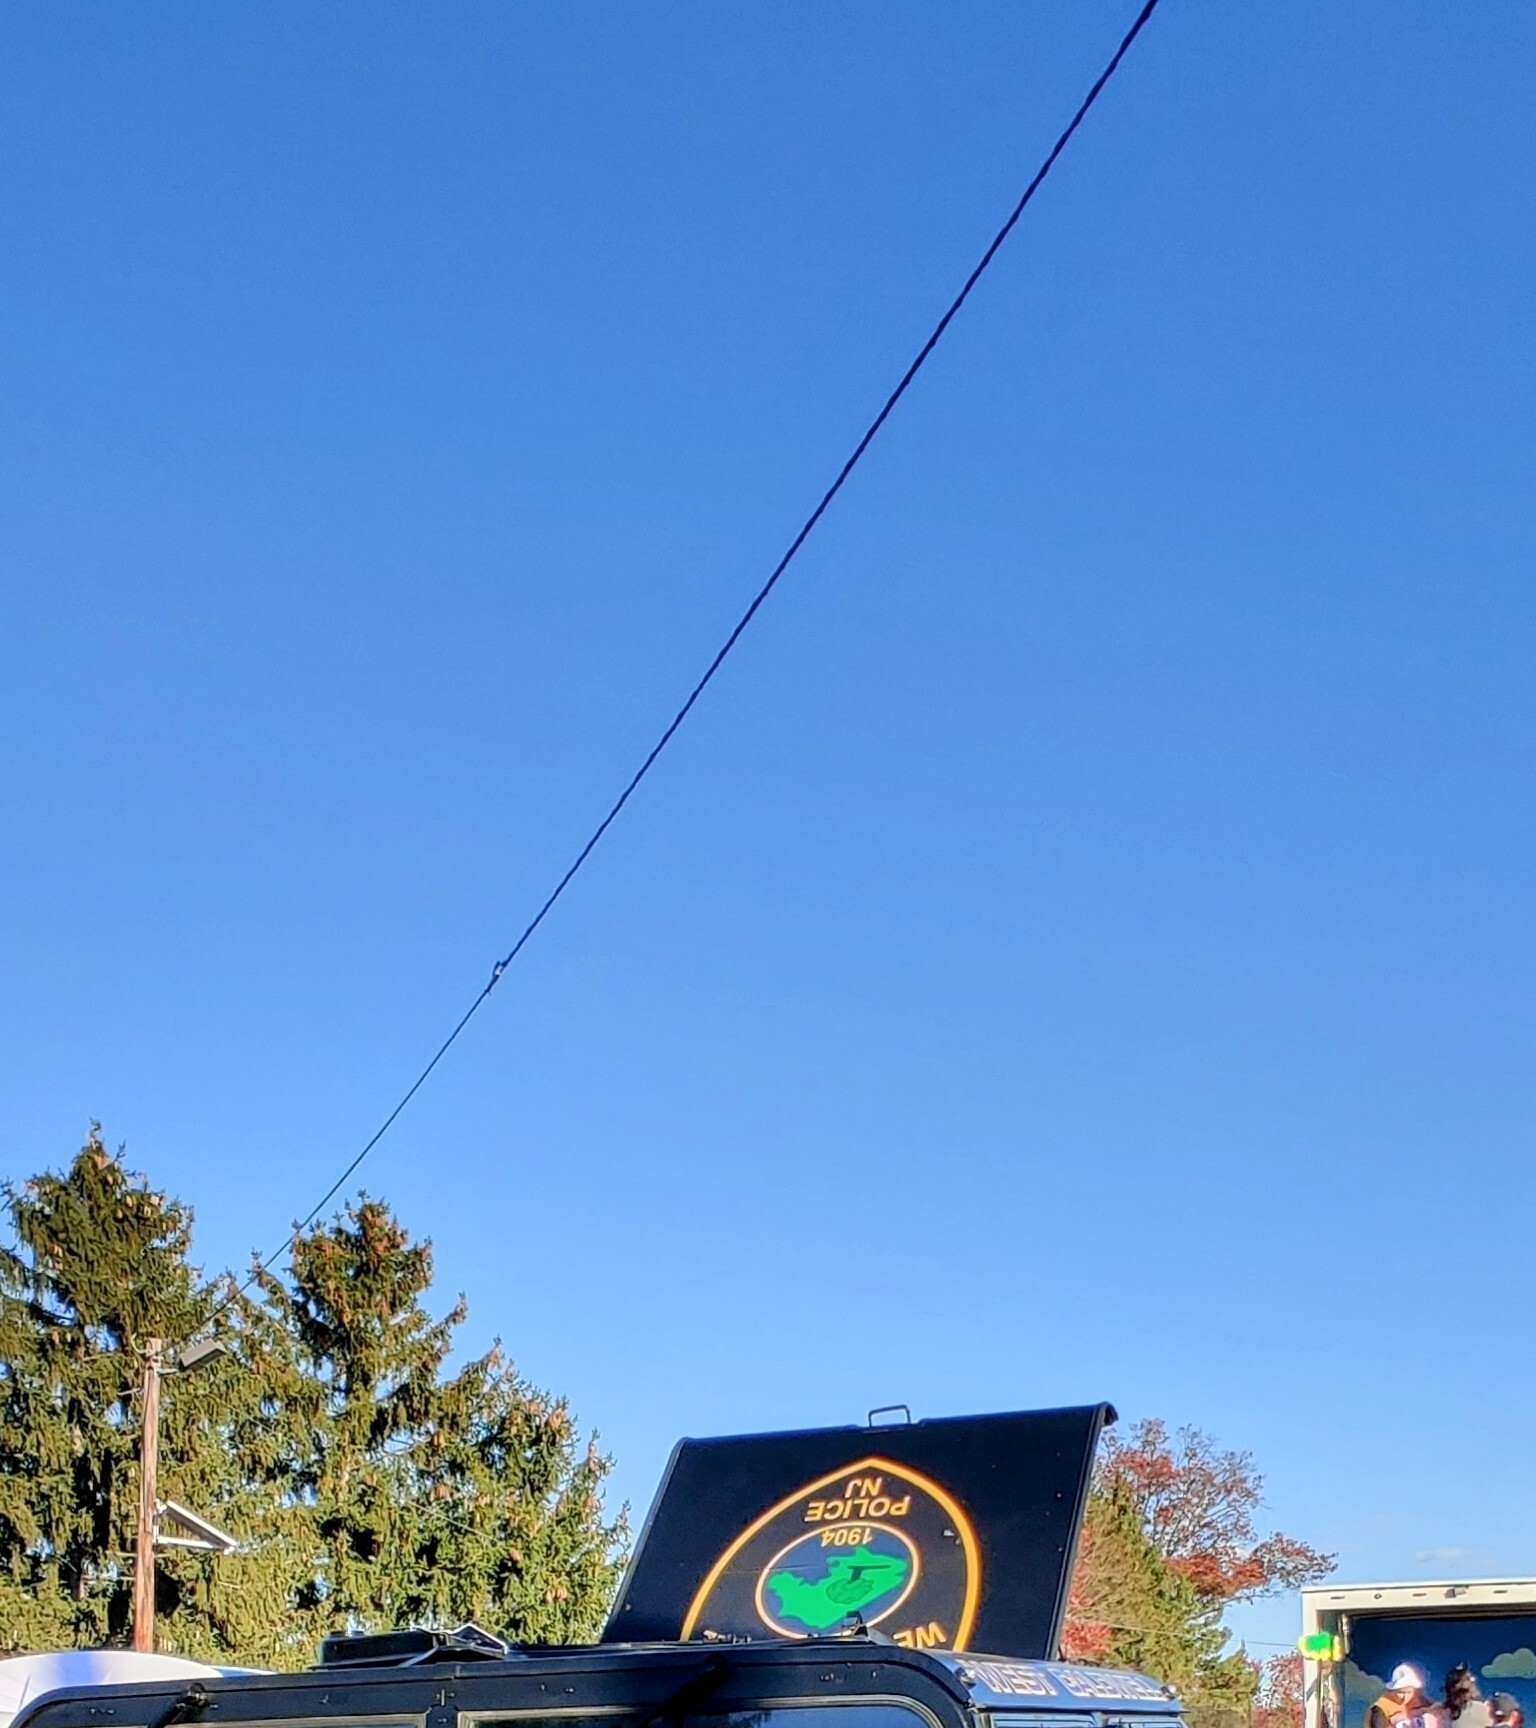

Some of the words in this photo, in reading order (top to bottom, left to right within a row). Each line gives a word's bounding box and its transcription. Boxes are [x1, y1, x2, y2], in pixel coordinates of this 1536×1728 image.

[844, 1477, 883, 1499] NJ
[804, 1494, 911, 1522] POLICE
[821, 1527, 873, 1547] 1904
[956, 1660, 1058, 1696] WEST
